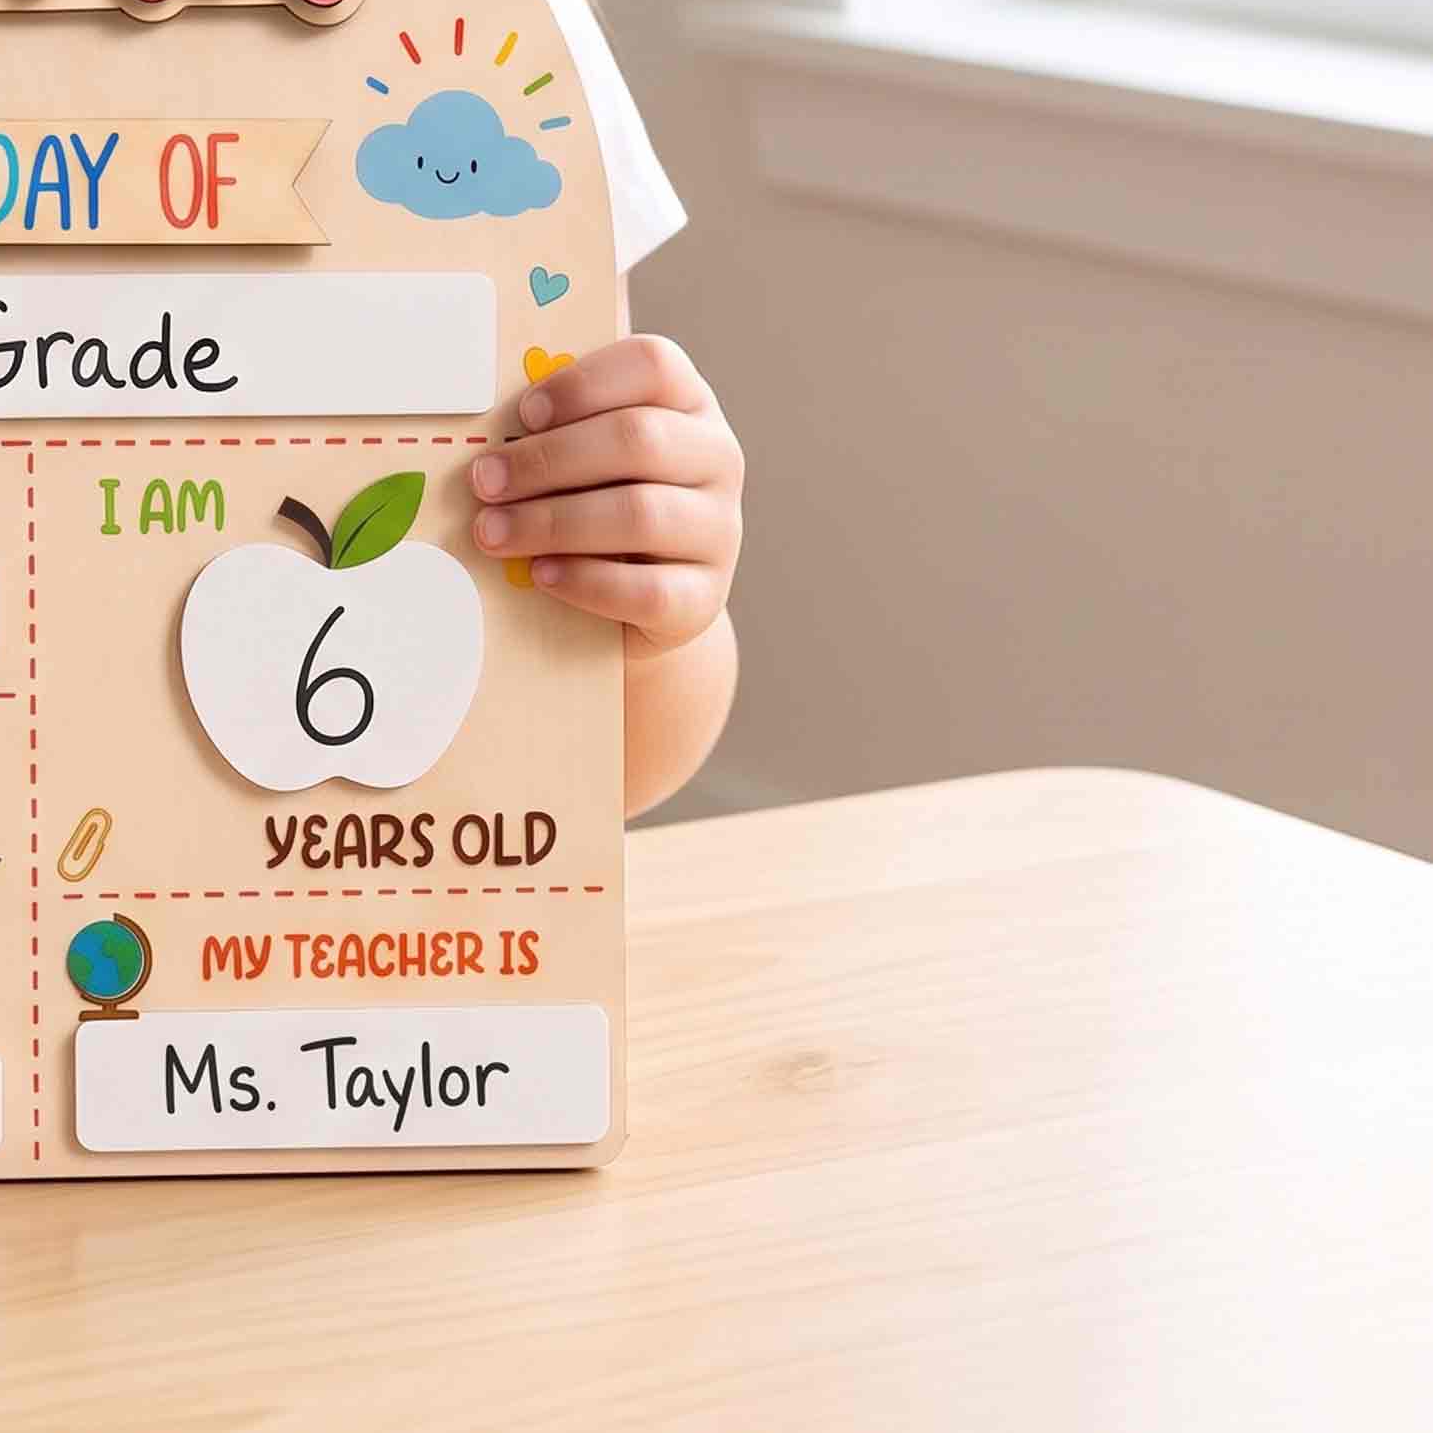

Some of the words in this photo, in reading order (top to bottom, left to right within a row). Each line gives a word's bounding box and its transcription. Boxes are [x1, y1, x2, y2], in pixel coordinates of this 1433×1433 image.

[159, 131, 241, 231] OF
[99, 478, 121, 535] I
[139, 478, 225, 534] AM
[295, 606, 375, 747] 6
[265, 814, 434, 869] YEARS
[451, 812, 557, 866] OLD
[201, 934, 272, 981] MY
[283, 932, 484, 976] TEACHER
[499, 930, 539, 975] IS
[165, 1043, 276, 1114] Ms.
[300, 1036, 509, 1133] Taylor
